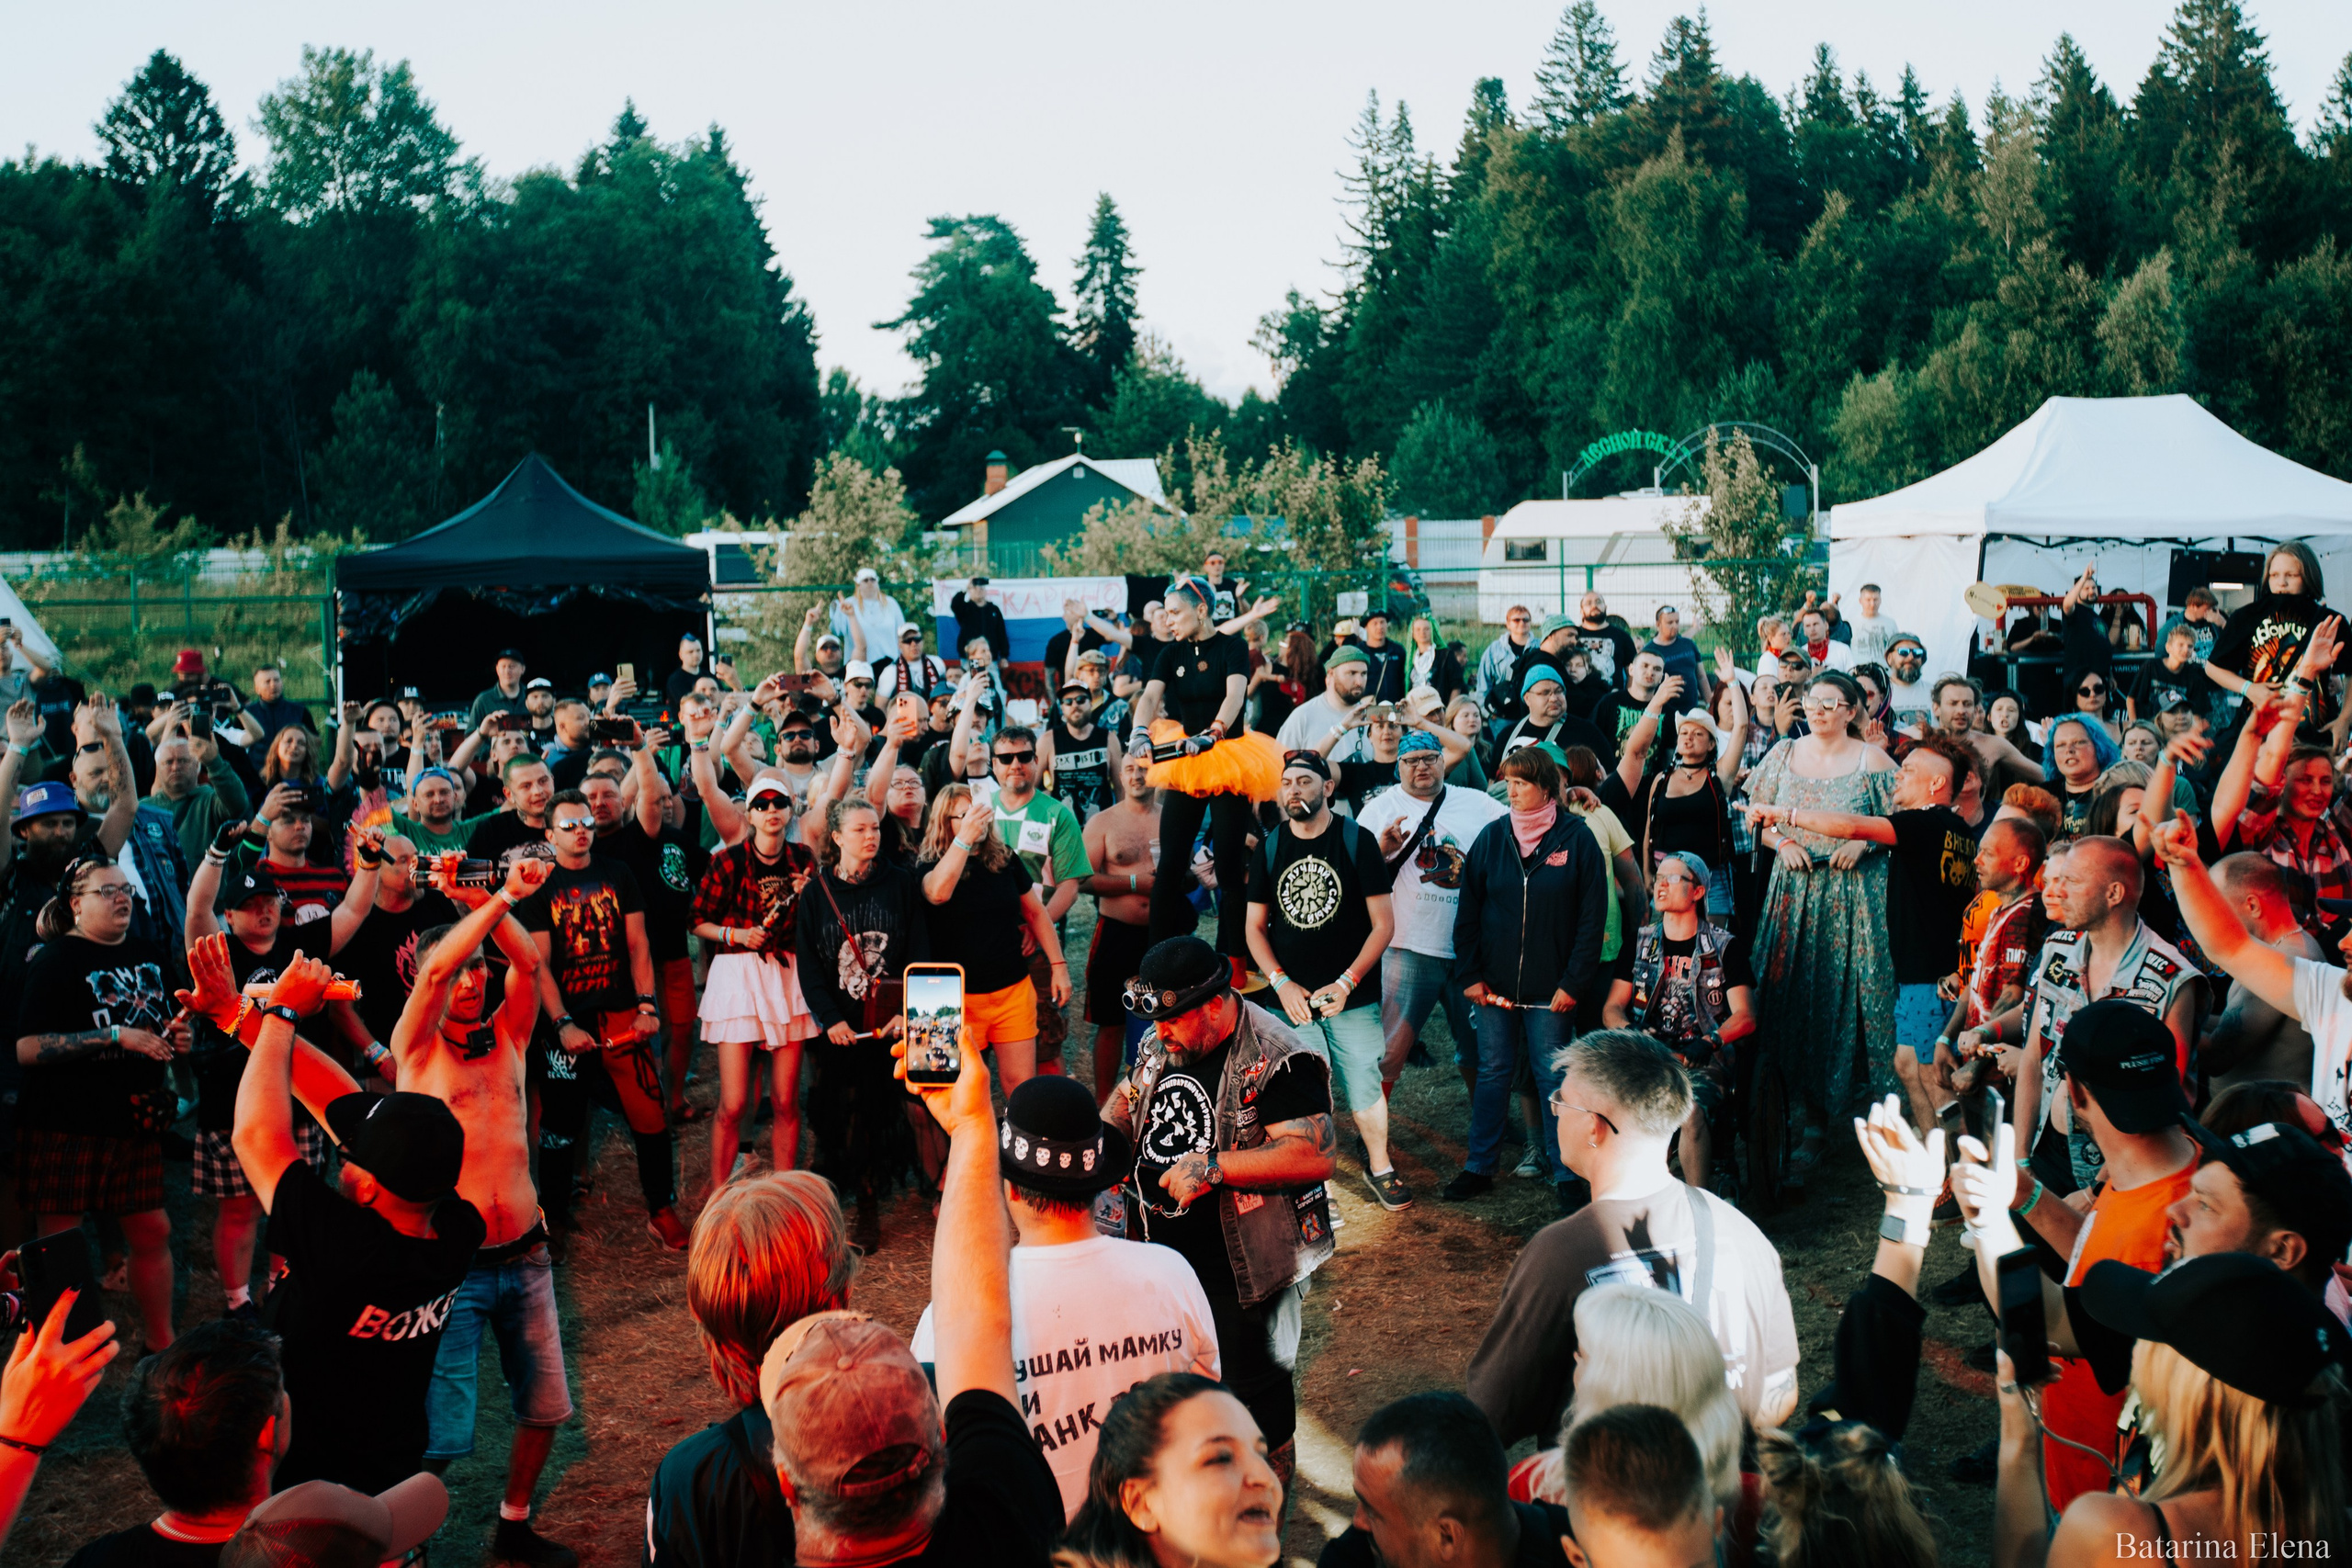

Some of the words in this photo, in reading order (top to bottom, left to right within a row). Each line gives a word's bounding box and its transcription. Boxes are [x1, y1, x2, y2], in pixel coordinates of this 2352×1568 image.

[1287, 863, 1331, 883] ЛУЧШИЙ
[1282, 882, 1299, 918] ДЕНЬ
[1307, 888, 1337, 924] САМЫЙ
[1015, 1337, 1091, 1382] УШАЙ
[1099, 1328, 1182, 1366] МАМКУ
[1034, 1403, 1102, 1453] АНК
